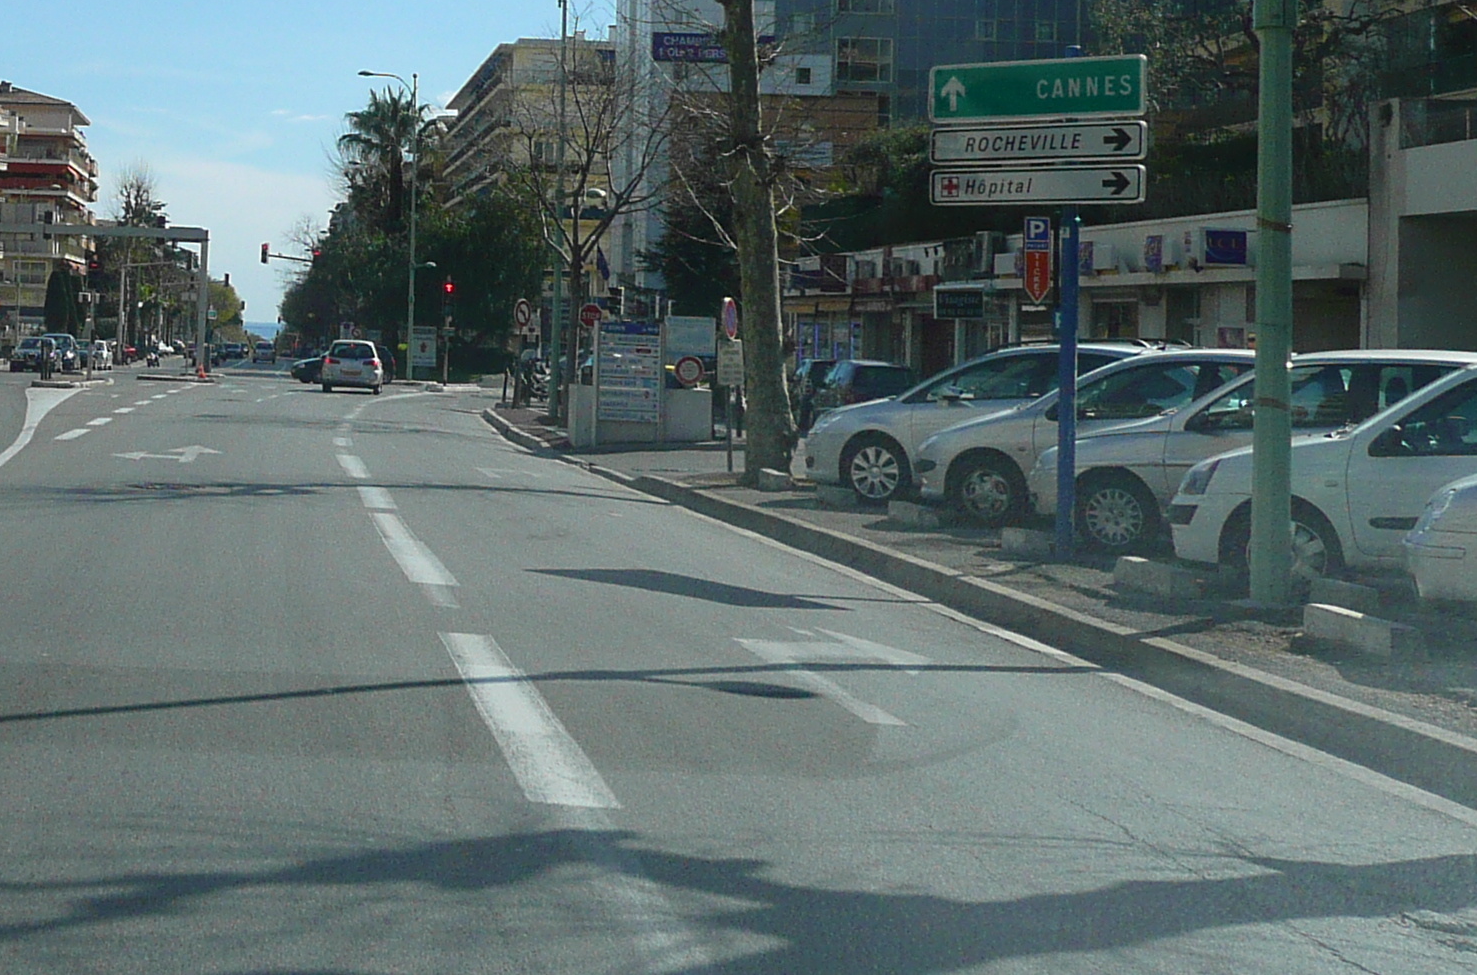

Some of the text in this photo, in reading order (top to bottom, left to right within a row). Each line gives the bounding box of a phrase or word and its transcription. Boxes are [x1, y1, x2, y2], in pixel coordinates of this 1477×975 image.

[1036, 75, 1133, 99] CANNES
[964, 133, 1082, 153] ROCHEVILLE
[964, 177, 1033, 198] Hôpital
[1029, 220, 1045, 239] P
[1032, 252, 1042, 298] TICKET
[582, 311, 601, 319] STOP
